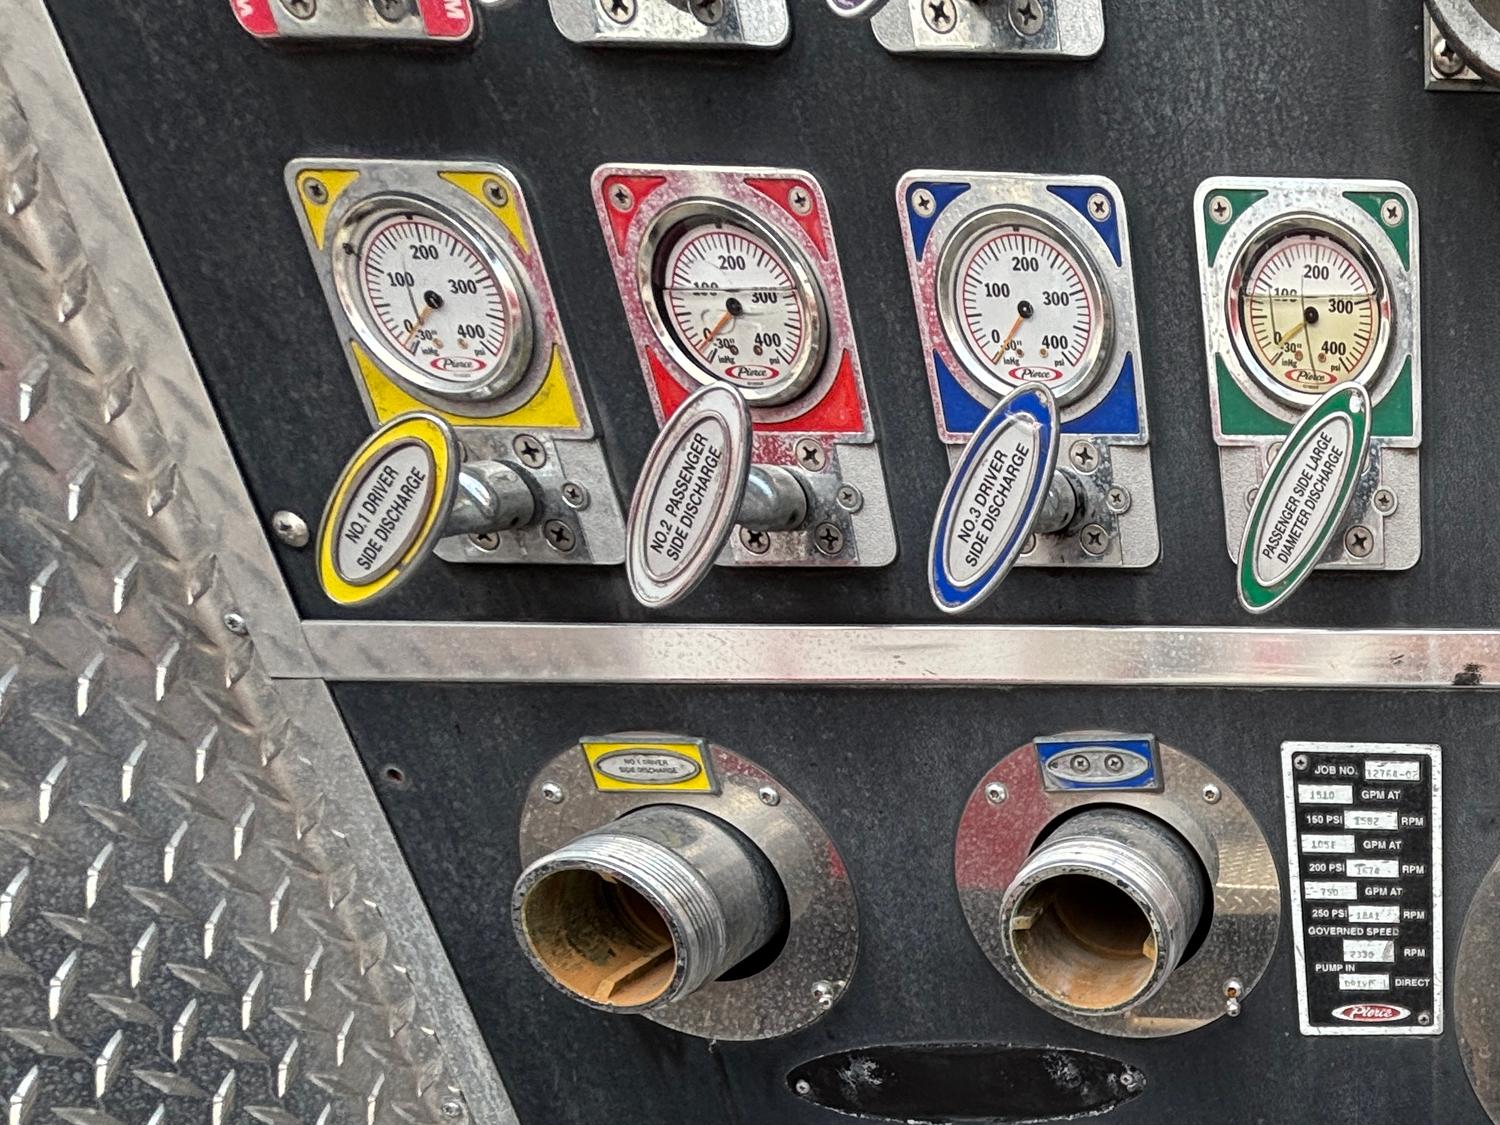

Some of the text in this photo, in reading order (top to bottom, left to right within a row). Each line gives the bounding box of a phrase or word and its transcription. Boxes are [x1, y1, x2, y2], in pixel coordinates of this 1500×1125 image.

[410, 245, 438, 259] 200
[718, 256, 745, 270] 200
[1012, 257, 1038, 271] 200
[388, 272, 414, 287] 100
[1304, 265, 1329, 280] 200
[448, 280, 477, 294] 300
[985, 283, 1009, 297] 100
[1043, 292, 1069, 306] 300
[1329, 299, 1353, 314] 300
[458, 325, 485, 338] 400
[992, 329, 1000, 343] 0
[755, 333, 781, 347] 400
[1042, 336, 1068, 349] 400
[1322, 341, 1346, 355] 400
[738, 367, 767, 377] Pierce
[1021, 369, 1050, 378] Pierce
[1298, 371, 1325, 381] Pierce
[650, 433, 708, 554] NO.2 PASSENGER
[958, 450, 1008, 543] NO.3 DRIVER
[1263, 432, 1332, 559] PASSENGER SIDE LARGE
[345, 465, 399, 544] NO.1 DRIVER
[667, 446, 722, 561] SIDE DISCHARGE
[966, 443, 1029, 566] SIDE DISCHARGE
[1278, 446, 1343, 563] DIAMETER DISCHARGE
[357, 467, 426, 570] SIDE DISCHARGE
[1315, 766, 1358, 775] JOB NO.
[1362, 791, 1400, 799] GPM AT
[1326, 816, 1342, 824] PSI
[1401, 817, 1423, 826] RPM
[1363, 841, 1401, 849] GPM AT
[1309, 864, 1424, 874] 200 PSI RPM
[1365, 888, 1402, 896] GPM AT
[1312, 909, 1424, 919] 250 PSI RPM
[1308, 926, 1399, 936] GOVERNED SPEED
[1316, 964, 1342, 972] PUMP
[1395, 978, 1430, 987] DIRECT
[1349, 1007, 1392, 1019] Pierce
